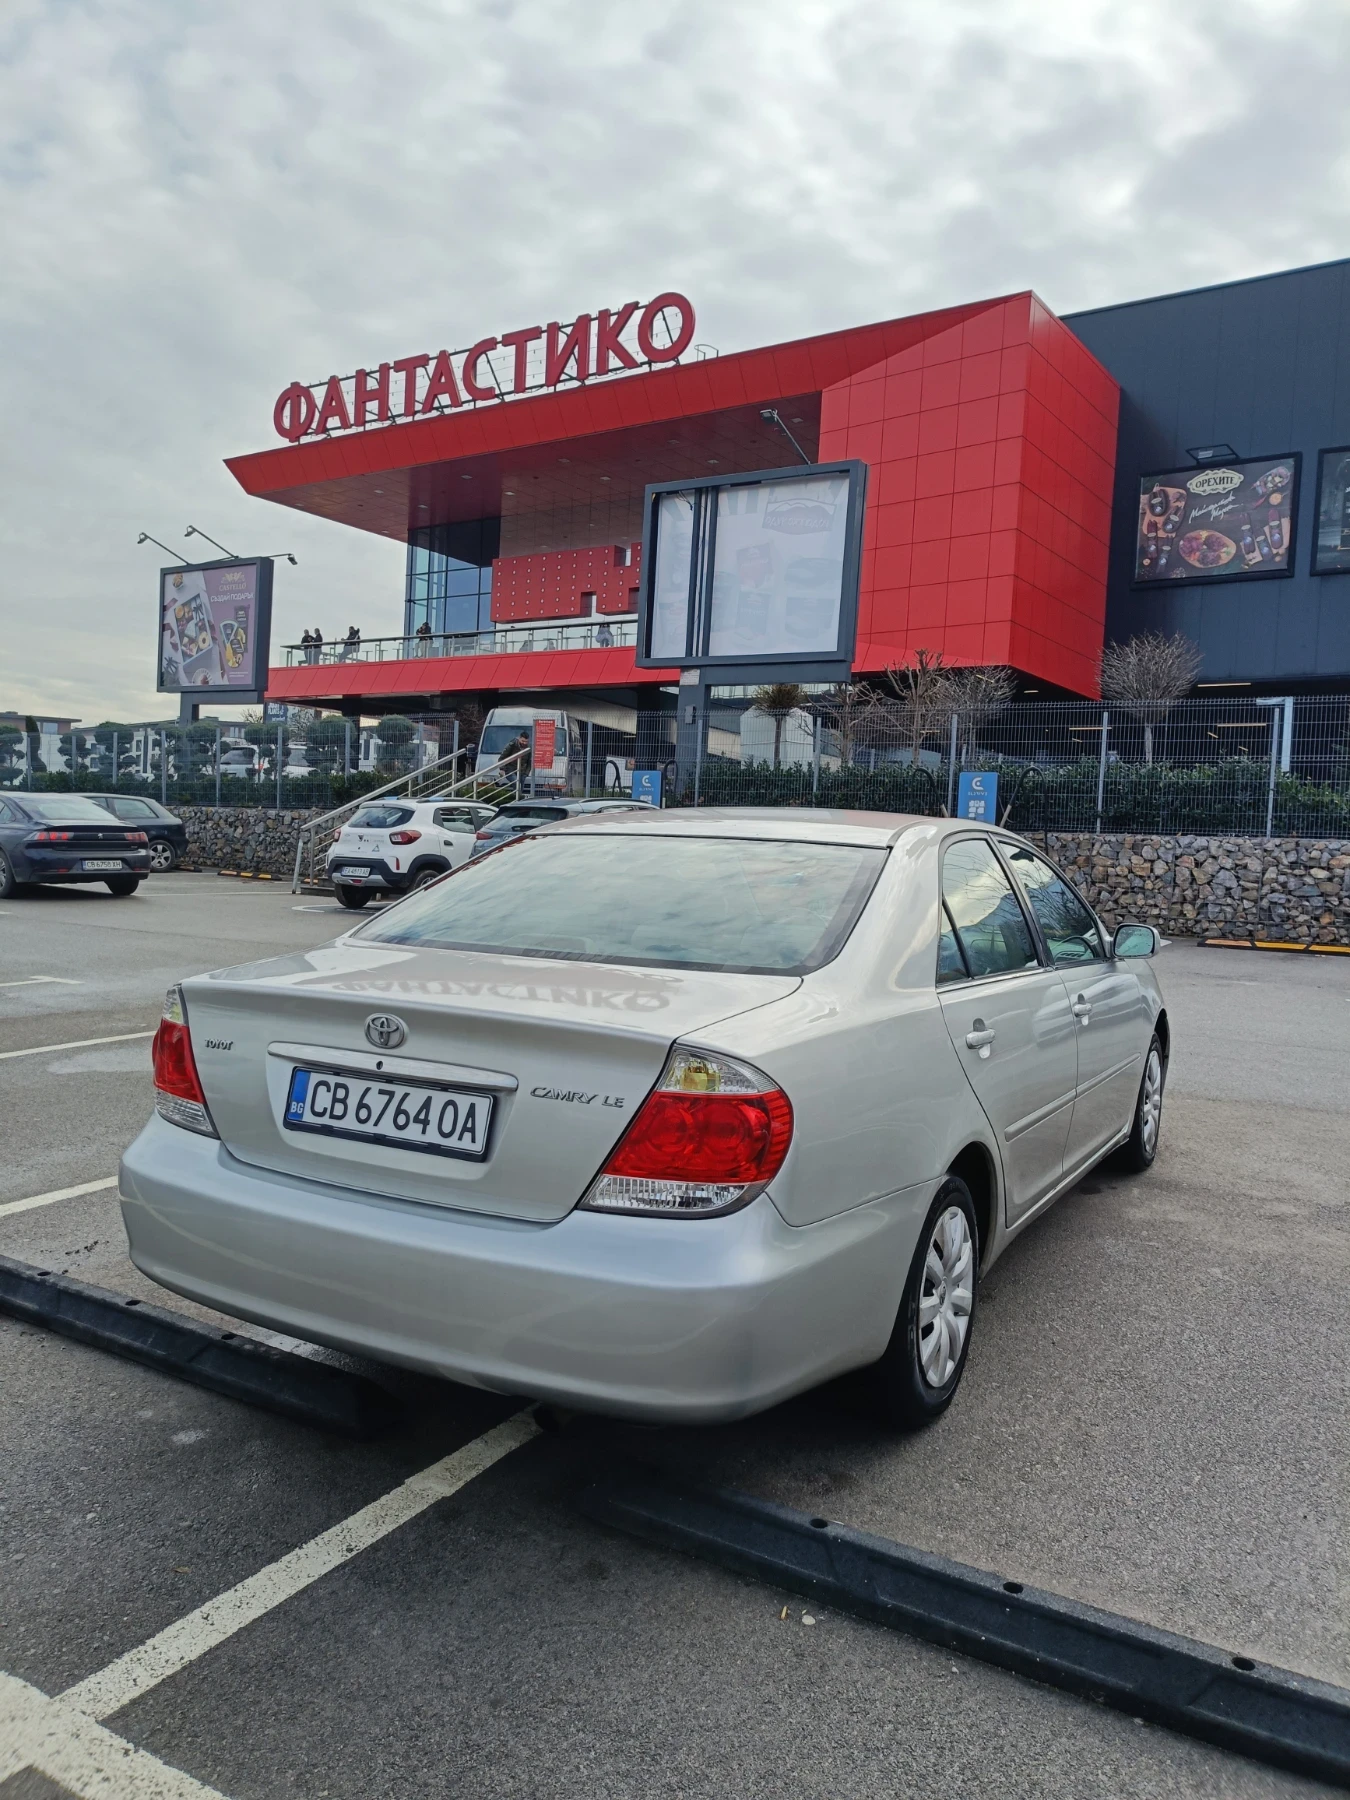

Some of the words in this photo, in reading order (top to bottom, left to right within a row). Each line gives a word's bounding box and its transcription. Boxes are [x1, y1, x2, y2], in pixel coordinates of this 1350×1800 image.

[273, 292, 696, 442] ФАНТАСТИКО
[219, 582, 247, 592] CASTELLO
[530, 1087, 599, 1105] CAMRY
[601, 1095, 625, 1109] LE
[290, 1101, 305, 1114] BG
